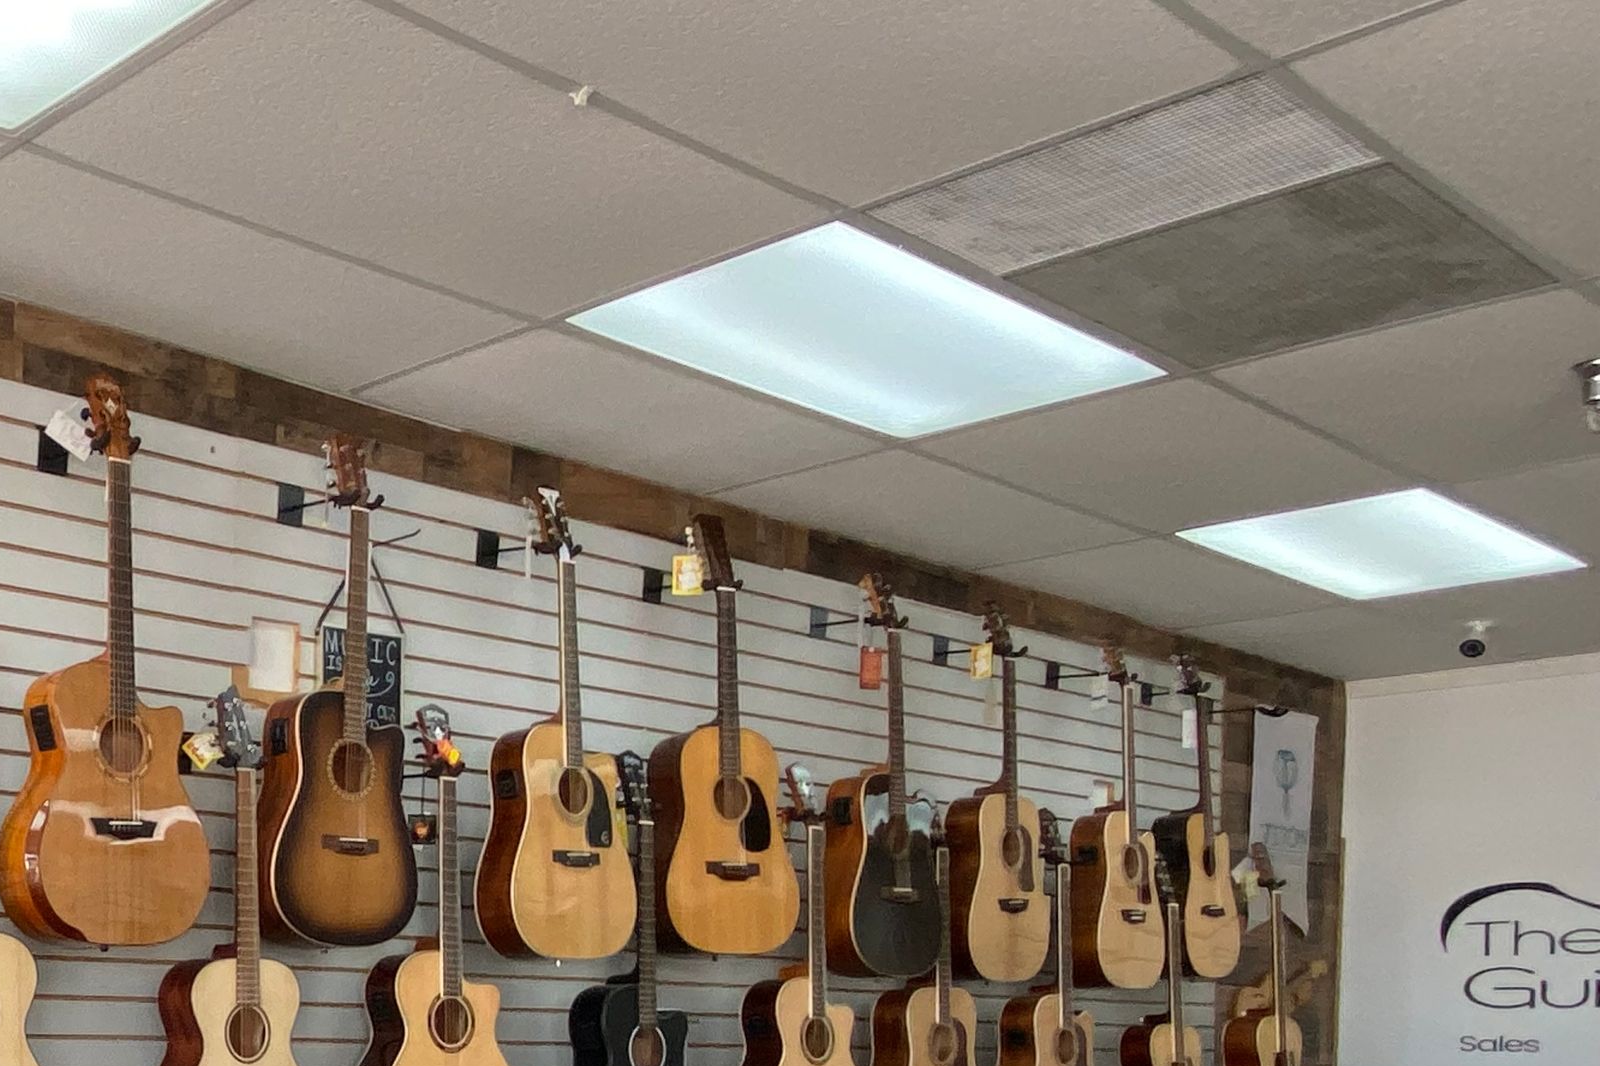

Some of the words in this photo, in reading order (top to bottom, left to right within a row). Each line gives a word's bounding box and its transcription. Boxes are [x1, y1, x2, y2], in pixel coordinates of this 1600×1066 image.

[325, 629, 398, 667] MIC
[1465, 920, 1600, 956] The
[1460, 1036, 1540, 1053] Sales
